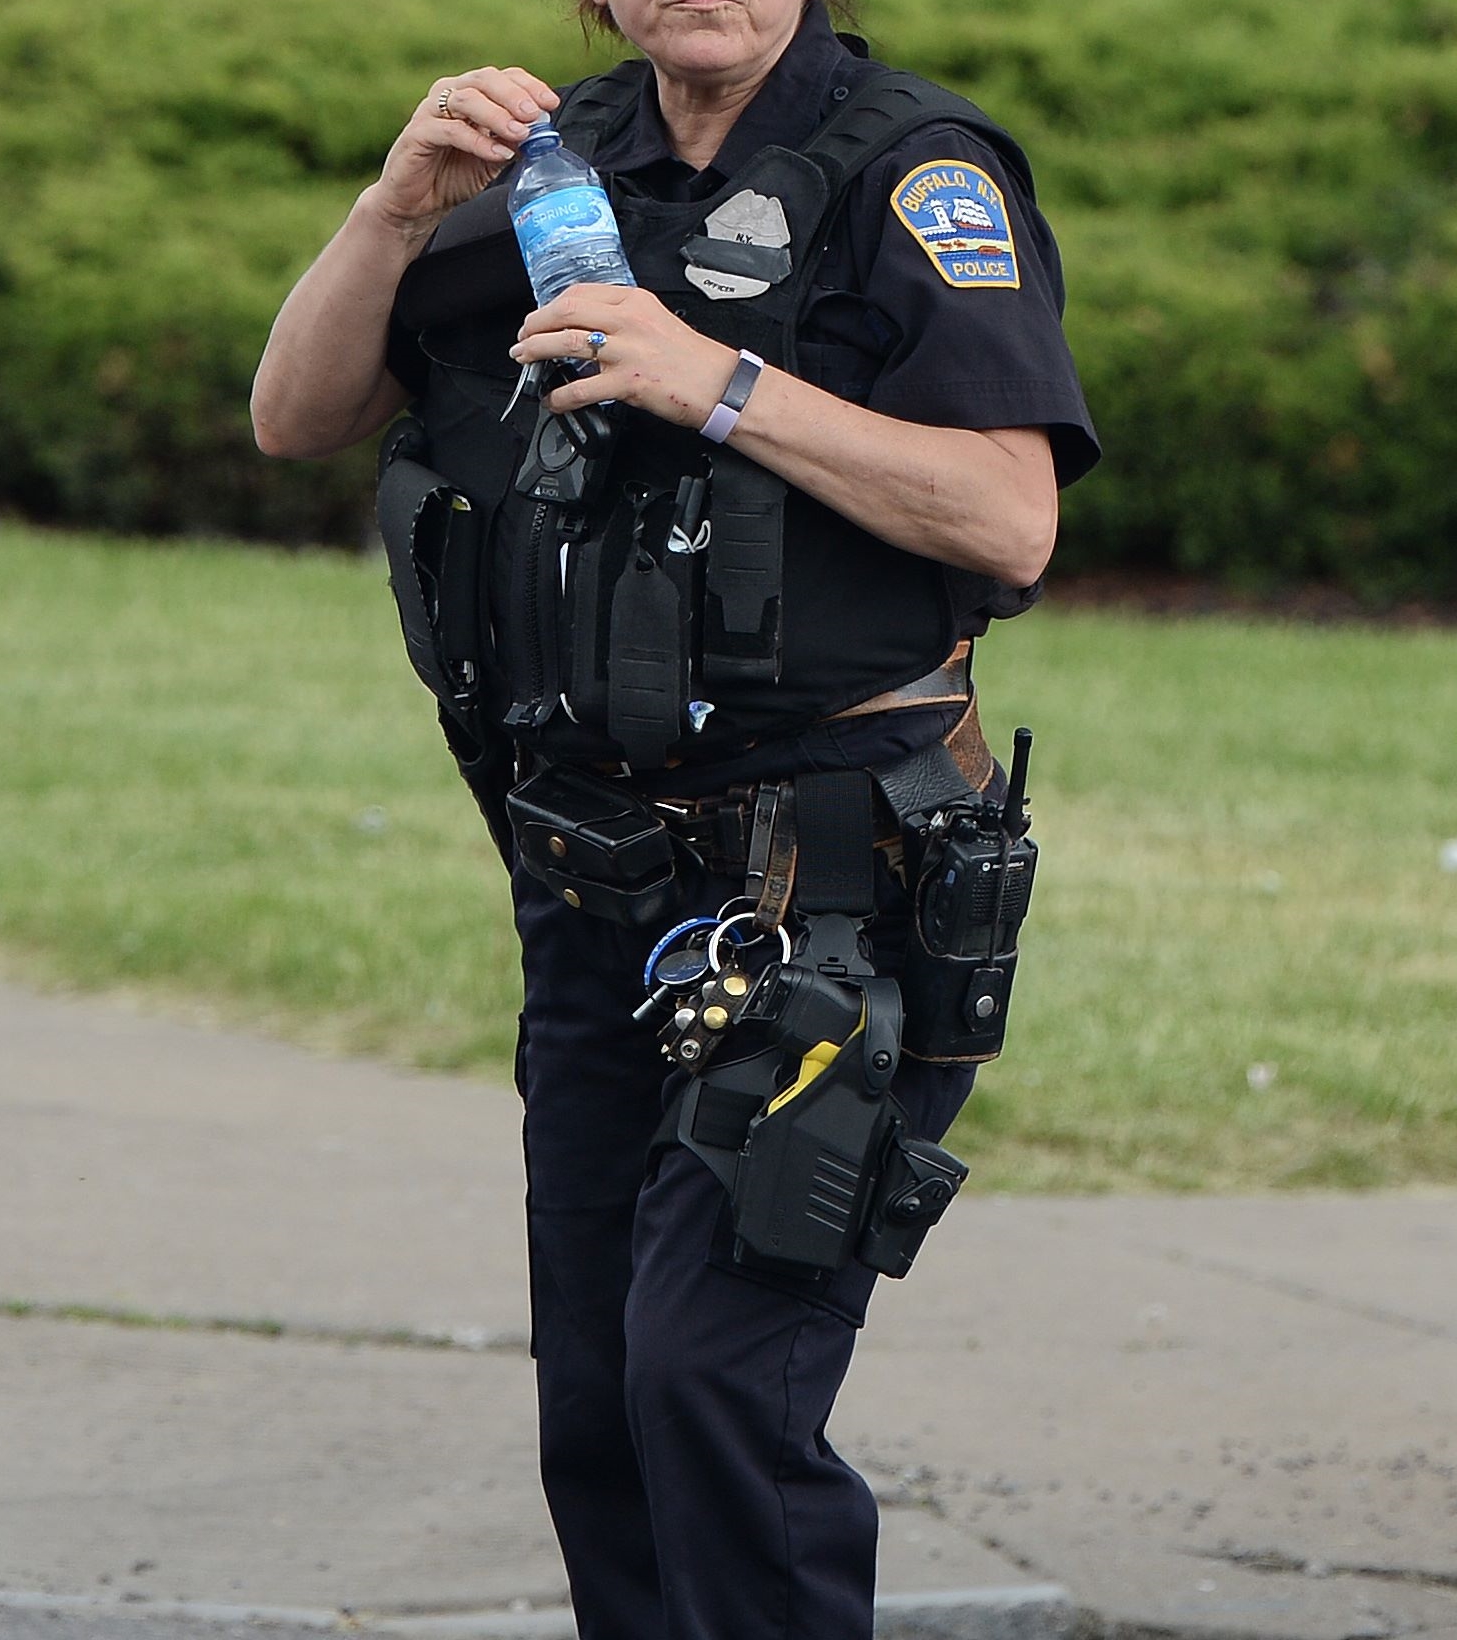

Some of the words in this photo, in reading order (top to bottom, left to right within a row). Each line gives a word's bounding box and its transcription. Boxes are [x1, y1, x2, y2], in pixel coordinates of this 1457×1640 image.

[902, 171, 971, 212] BUFFALO,
[532, 202, 579, 228] SPRING
[953, 262, 1010, 277] POLICE
[703, 279, 735, 293] OFFICER
